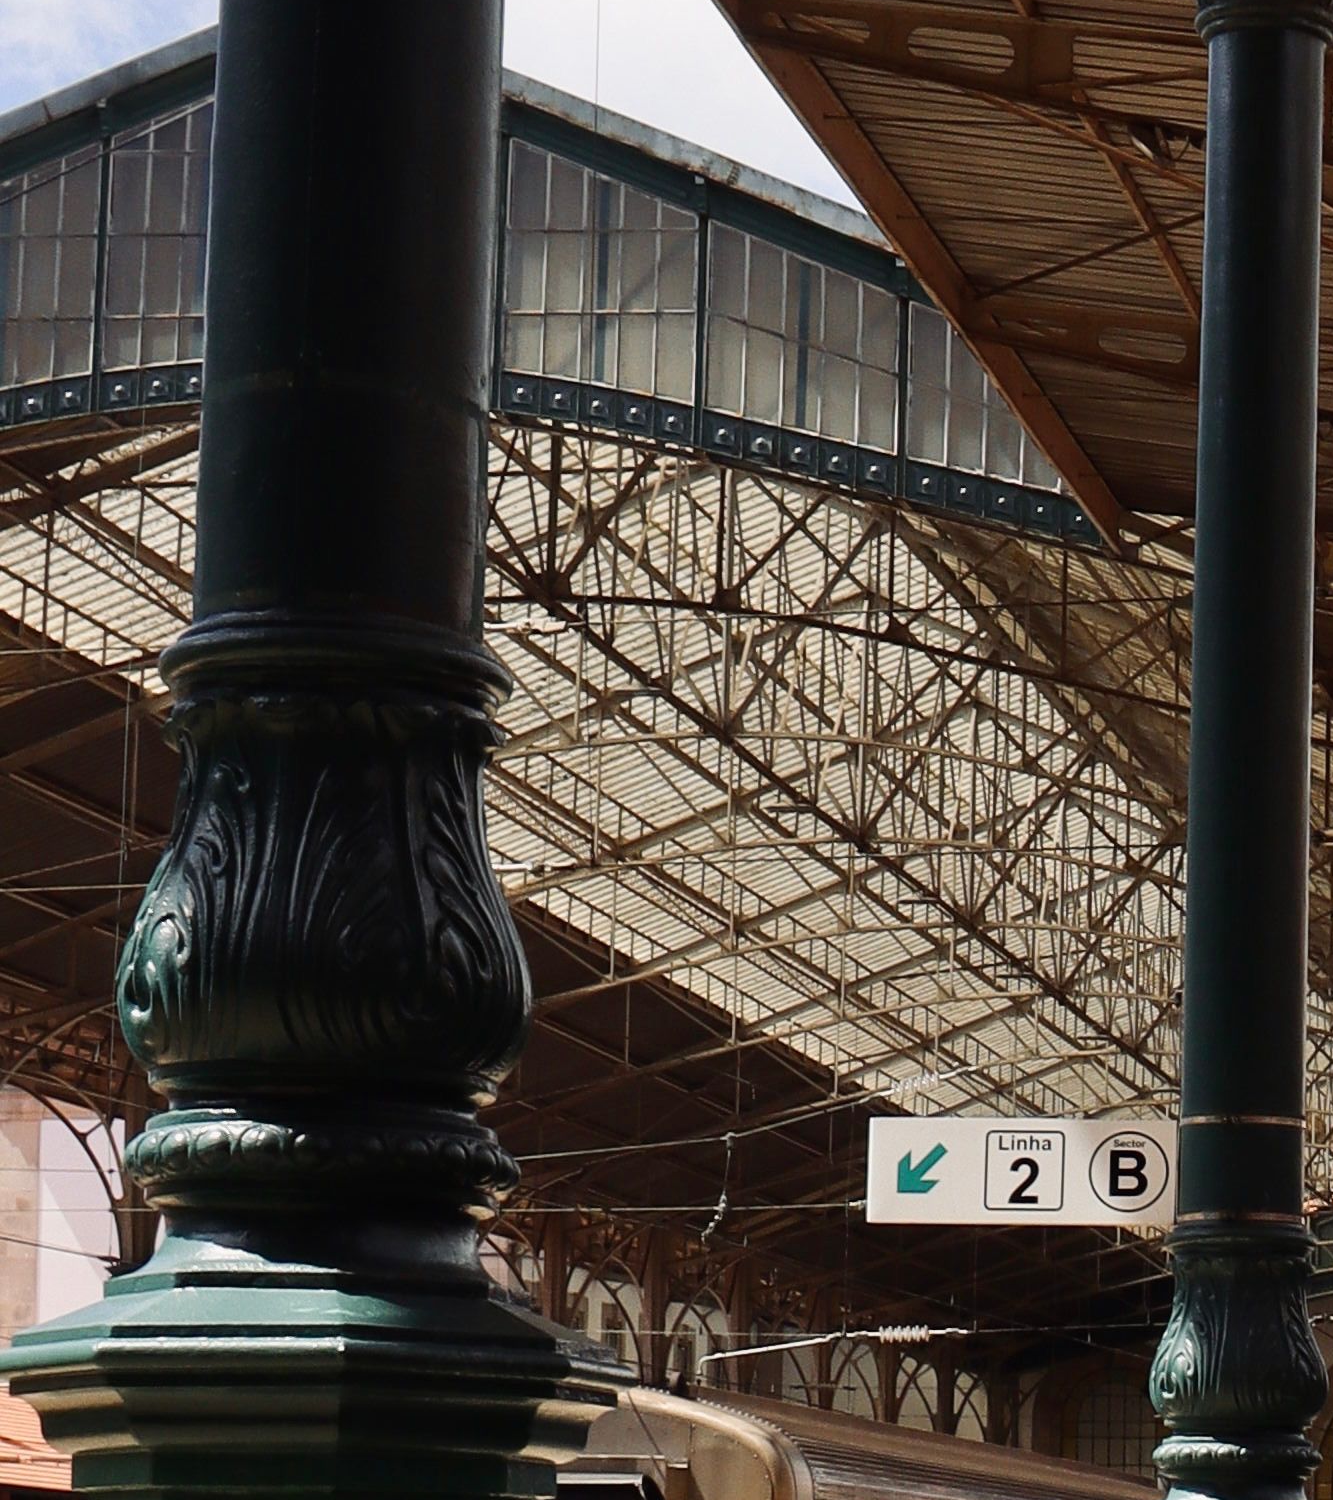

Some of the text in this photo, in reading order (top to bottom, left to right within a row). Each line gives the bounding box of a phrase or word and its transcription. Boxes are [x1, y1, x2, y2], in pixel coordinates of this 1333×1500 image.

[998, 1135, 1052, 1151] Linha
[1113, 1138, 1146, 1148] Sector
[1007, 1157, 1040, 1204] 2
[1109, 1149, 1149, 1197] B
